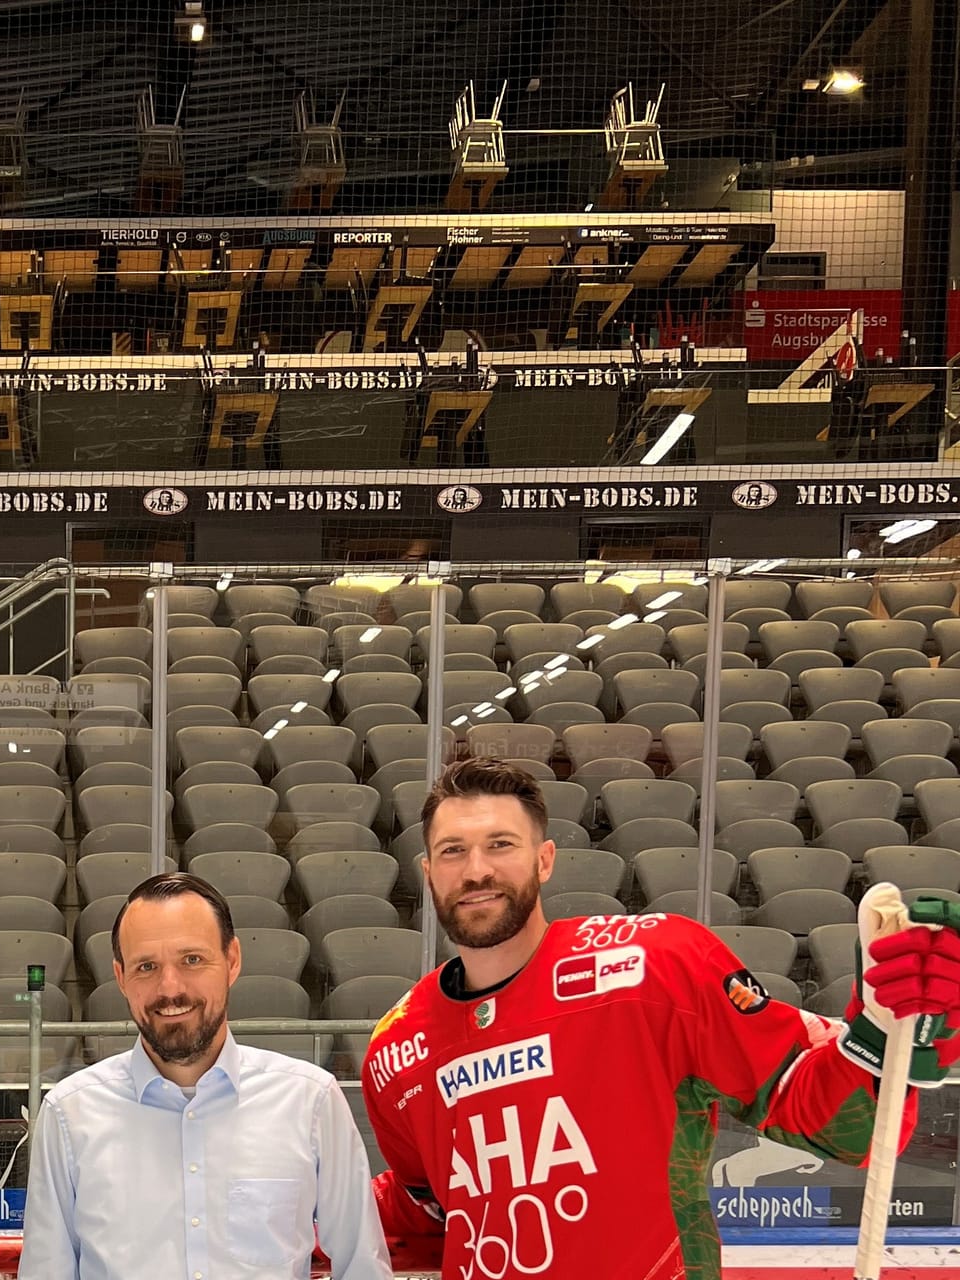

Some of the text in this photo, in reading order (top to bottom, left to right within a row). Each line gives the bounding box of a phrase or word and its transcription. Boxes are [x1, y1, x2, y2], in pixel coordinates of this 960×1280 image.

[100, 229, 159, 240] TIERHOLD
[333, 232, 392, 244] REPORTER
[773, 313, 888, 329] Stadtsparsse
[206, 490, 402, 511] MEIN-BOBS.DE
[500, 487, 699, 509] MEIN-BOBS.DE
[440, 1044, 546, 1099] HAIMER
[716, 1186, 813, 1227] scheppach
